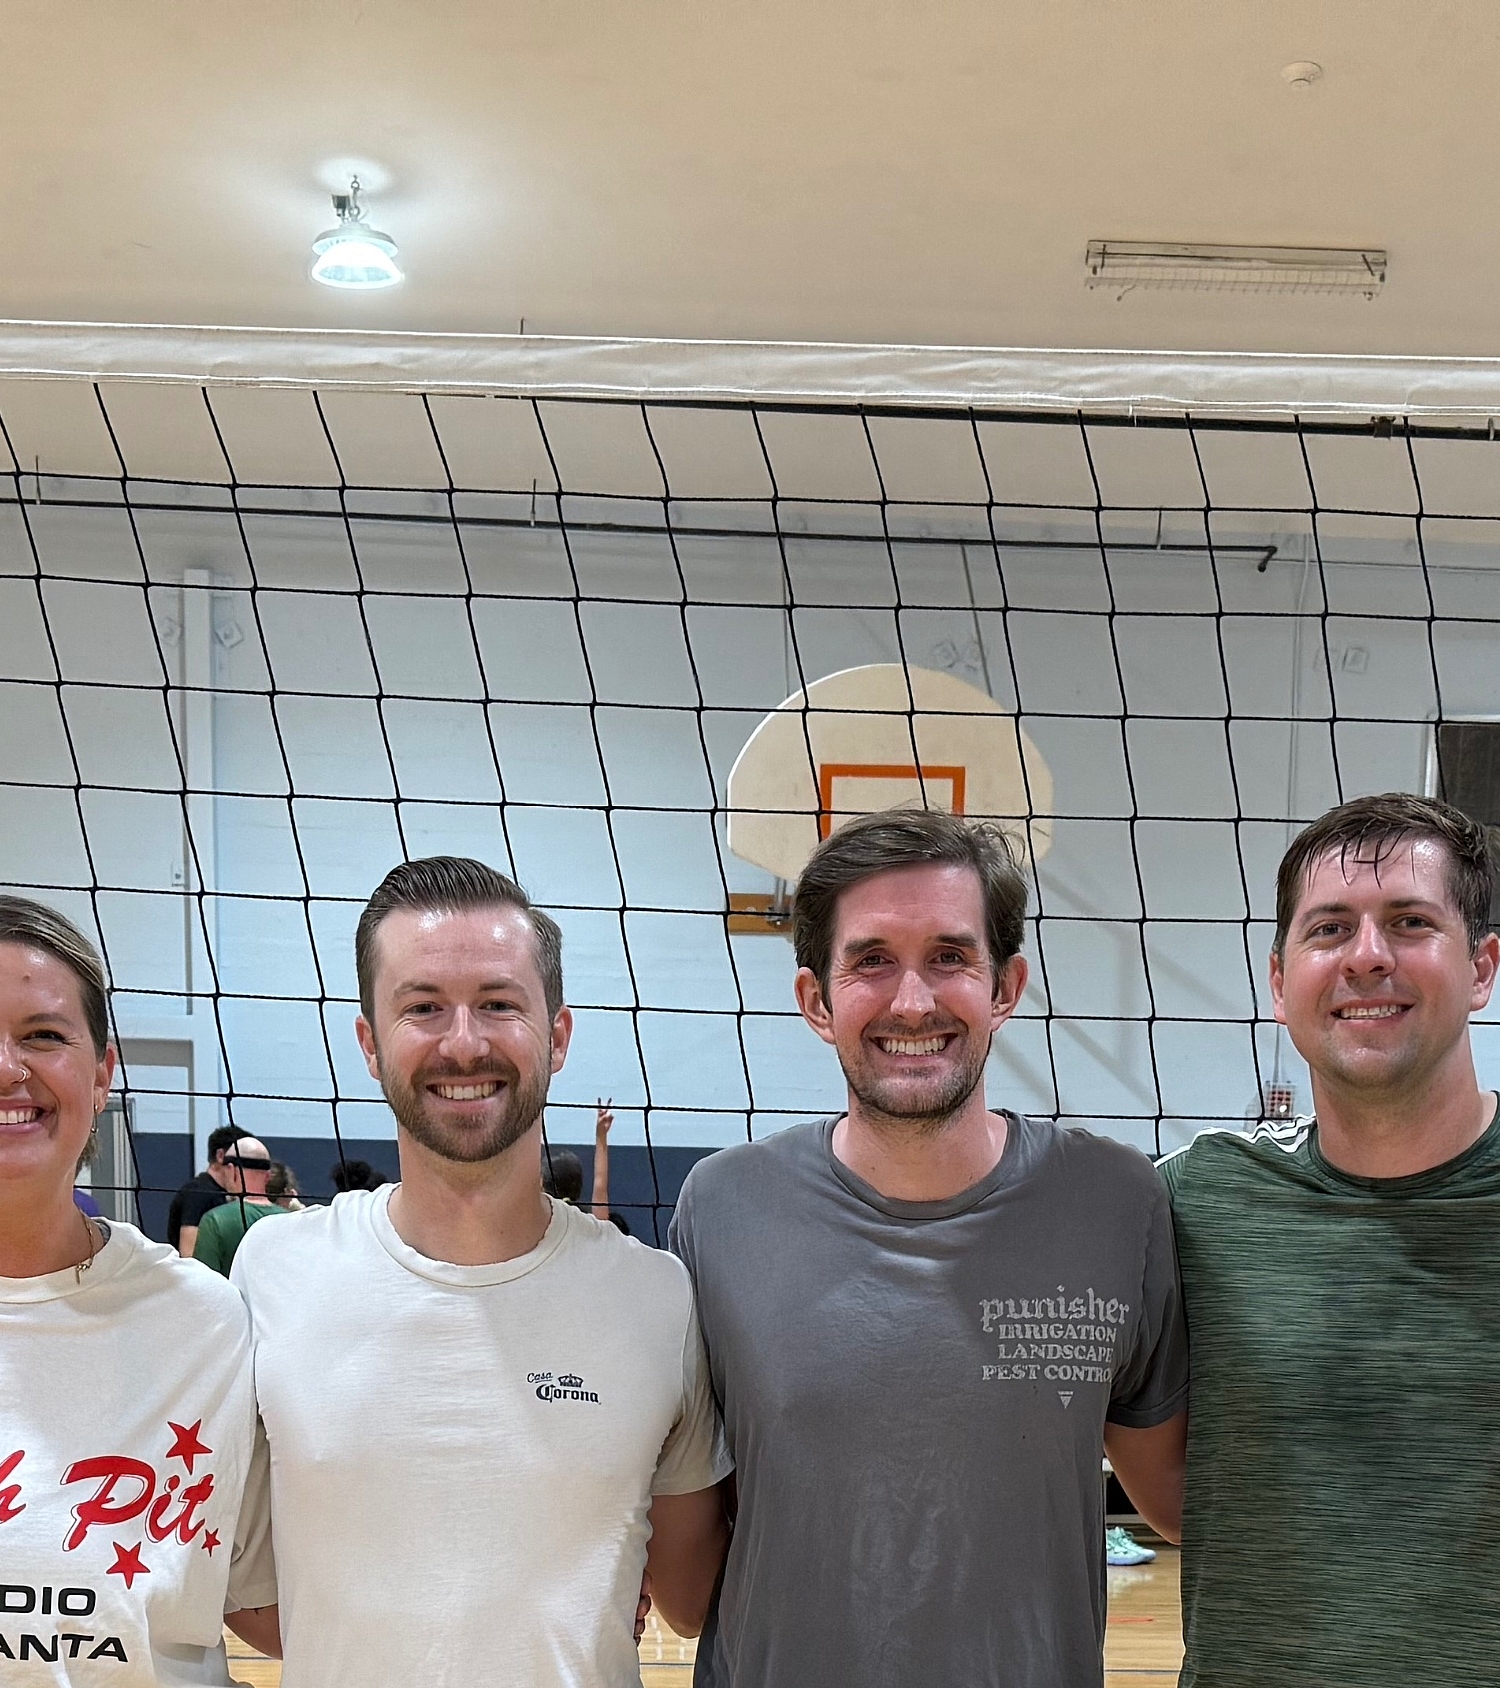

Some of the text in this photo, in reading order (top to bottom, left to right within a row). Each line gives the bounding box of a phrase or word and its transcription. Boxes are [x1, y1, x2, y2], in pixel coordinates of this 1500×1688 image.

[979, 1285, 1130, 1332] punisher
[998, 1323, 1117, 1343] IRRIGATION
[527, 1372, 553, 1383] Casa
[982, 1365, 1112, 1383] PEST CONTRO
[535, 1384, 600, 1404] Corona
[60, 1455, 216, 1552] Pit
